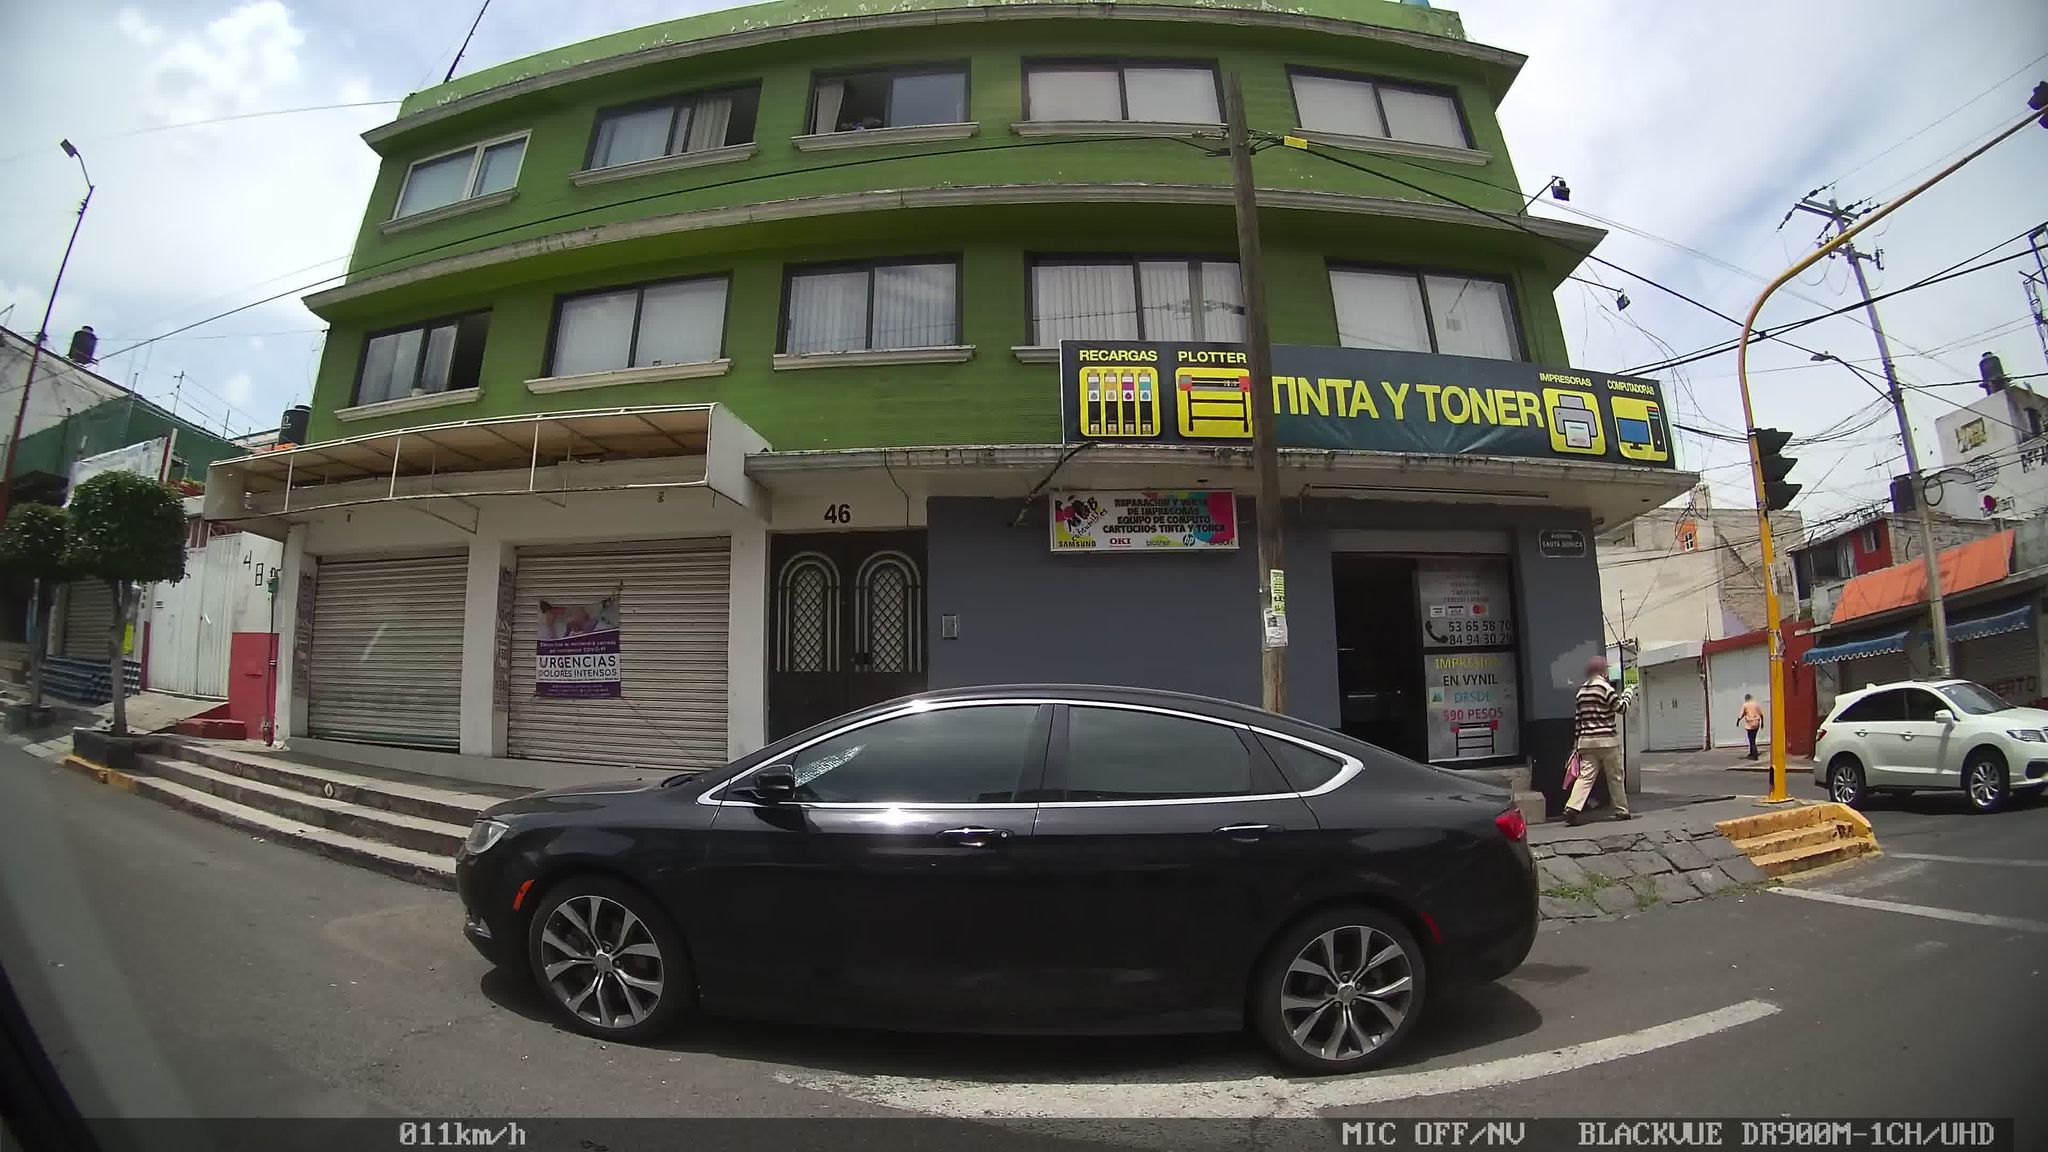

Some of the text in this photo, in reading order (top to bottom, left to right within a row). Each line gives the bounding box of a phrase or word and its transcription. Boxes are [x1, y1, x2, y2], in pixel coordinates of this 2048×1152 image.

[1079, 350, 1158, 362] RECARGAS
[1178, 351, 1247, 363] PLOTTER
[1539, 373, 1592, 387] IMPRESORAS
[1606, 380, 1655, 395] COMPUTADORAS
[1271, 376, 1545, 428] TINTA Y TONER
[823, 503, 851, 524] 46
[1127, 507, 1140, 516] DE
[1117, 516, 1210, 525] EQUIPO DE COMPUTO
[1103, 525, 1157, 534] CARTUCHOS
[1159, 525, 1186, 533] TINTA
[1195, 524, 1226, 533] TONER
[1058, 540, 1097, 548] SAMSUNG
[1109, 537, 1131, 545] OKI
[1448, 620, 1512, 632] 53 65 58 70
[1449, 635, 1463, 645] 84
[1466, 634, 1480, 644] 94
[1484, 634, 1497, 644] 30
[539, 655, 617, 669] URGENCIAS
[538, 668, 617, 678] DOLORES INTENSOS
[1443, 673, 1498, 687] EN VYNIL
[1467, 707, 1504, 720] PESOS
